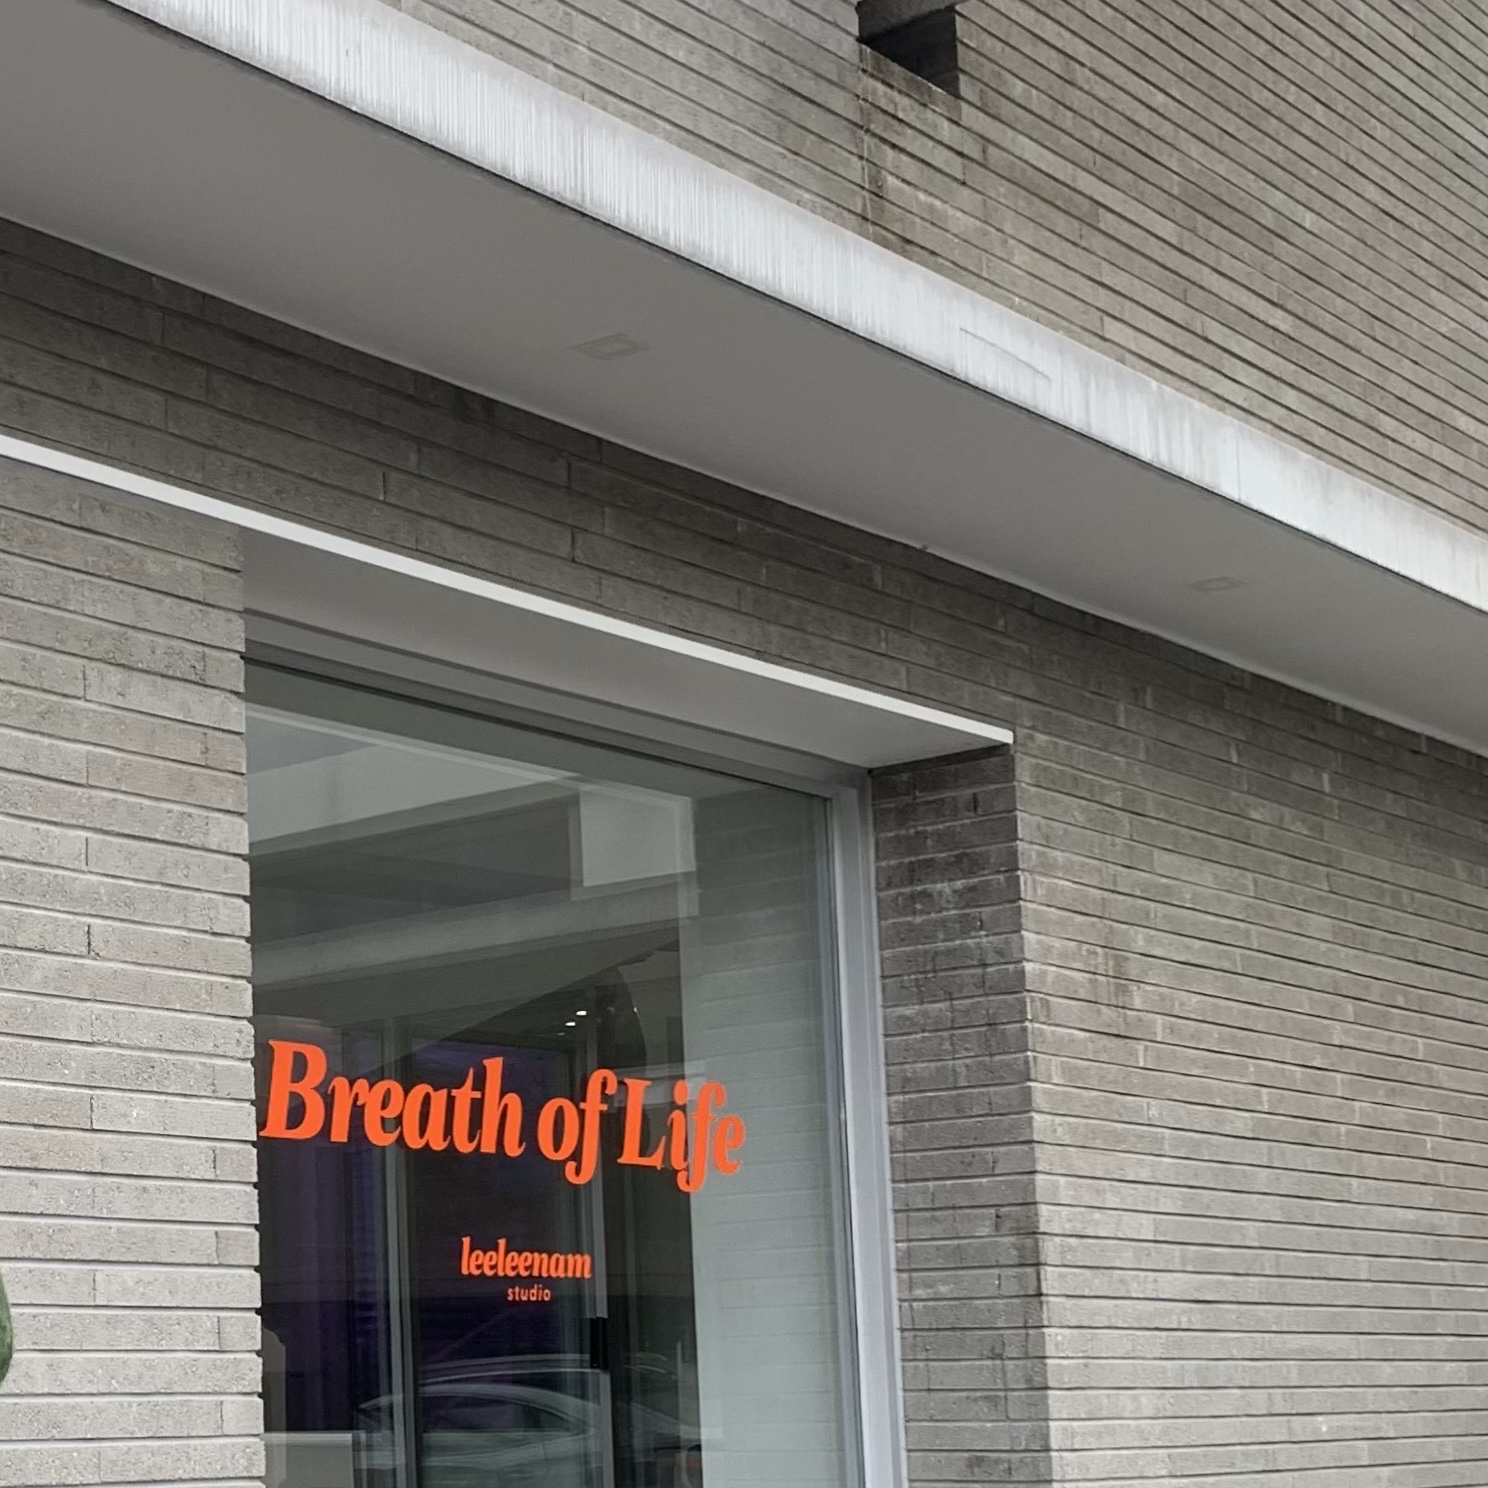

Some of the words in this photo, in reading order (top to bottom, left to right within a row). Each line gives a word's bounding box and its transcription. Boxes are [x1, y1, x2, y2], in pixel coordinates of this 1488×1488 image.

[259, 1039, 525, 1158] Breath
[537, 1068, 618, 1185] of
[618, 1077, 746, 1194] Life
[460, 1236, 592, 1279] leeleenam
[507, 1284, 551, 1302] studio
